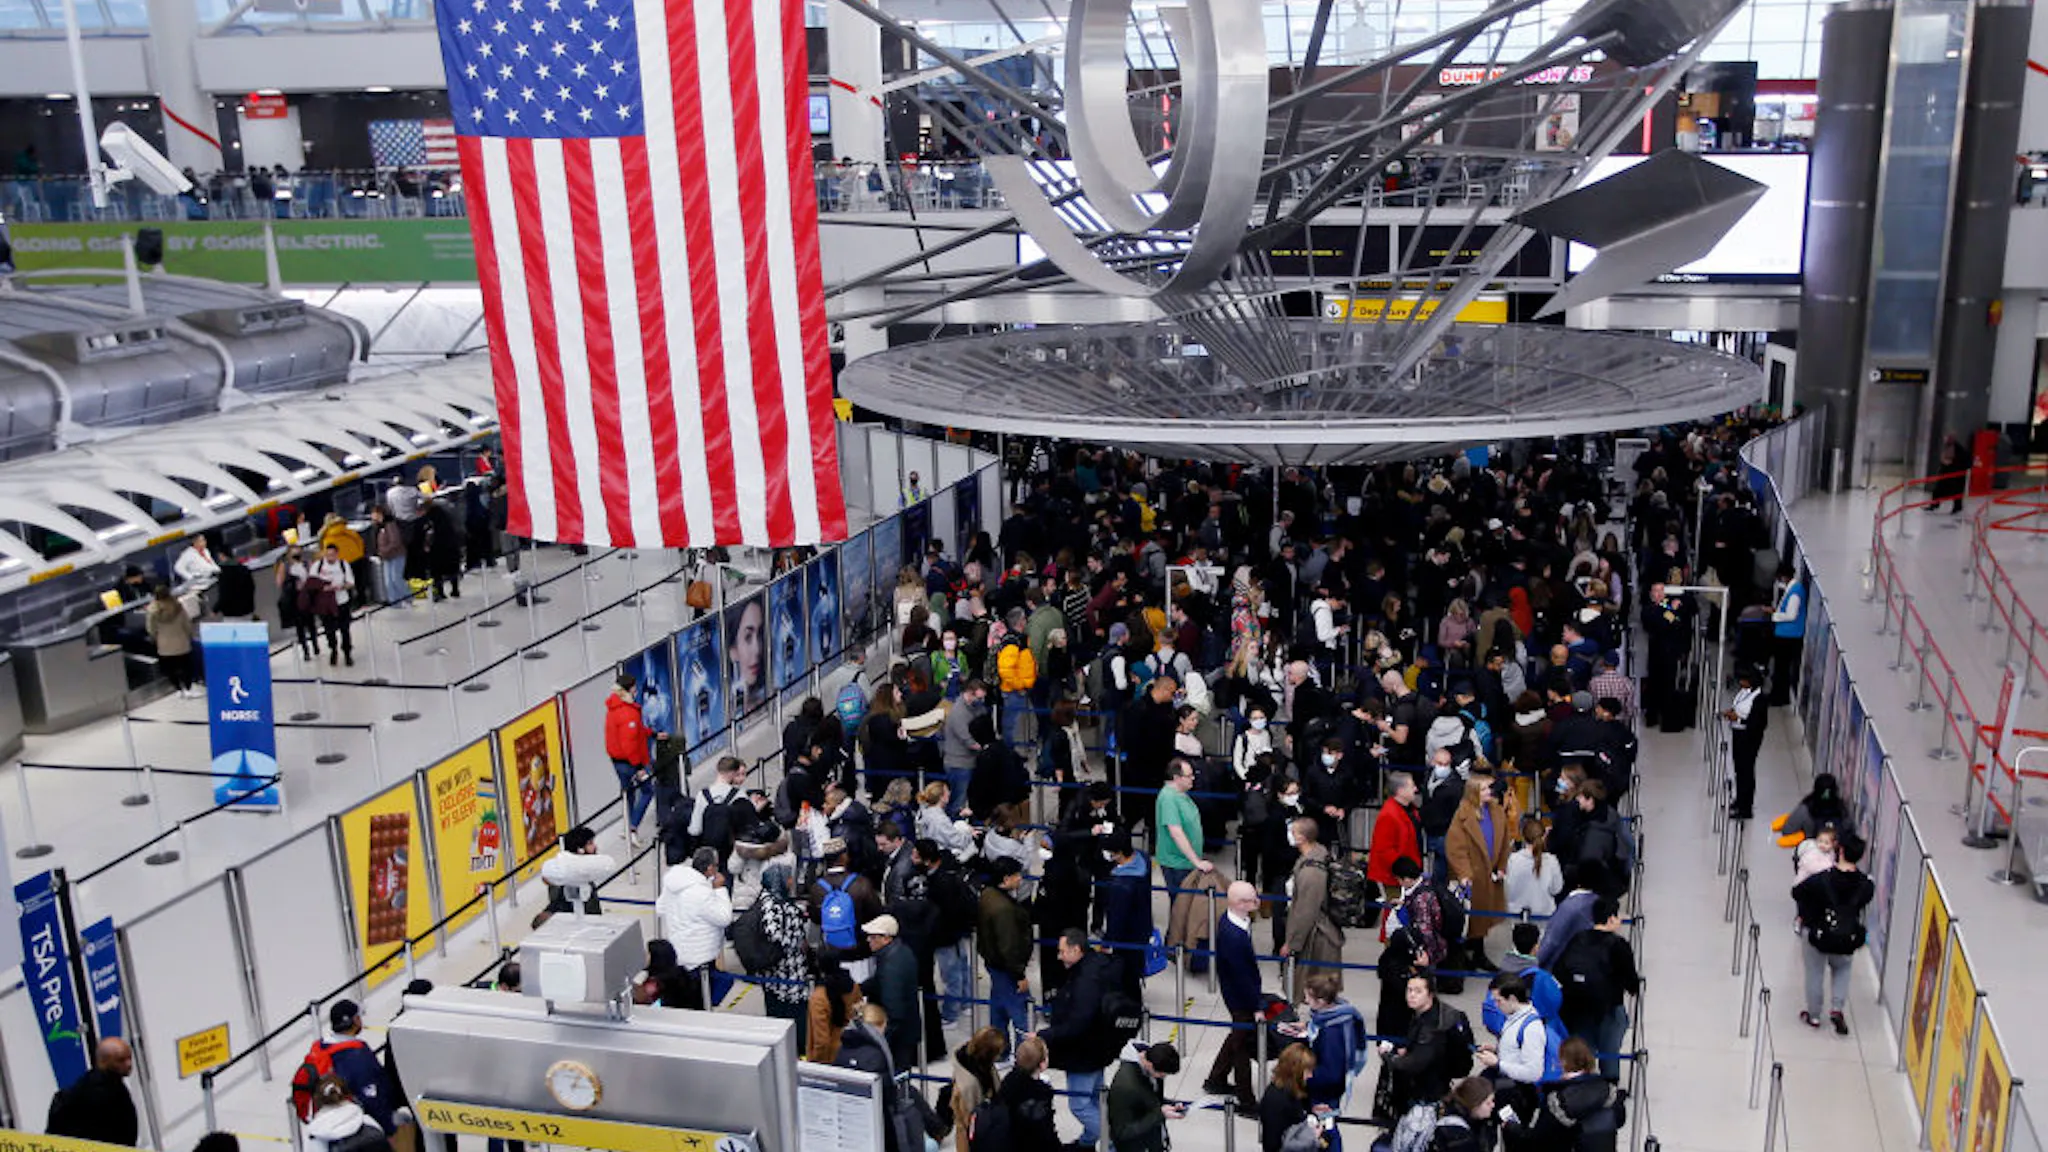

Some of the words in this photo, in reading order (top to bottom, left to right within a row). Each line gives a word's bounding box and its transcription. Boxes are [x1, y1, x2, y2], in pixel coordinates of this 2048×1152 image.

[13, 237, 82, 251] GOING
[167, 236, 196, 250] BY
[221, 710, 260, 721] NORSE
[31, 922, 57, 979] TSA
[428, 1109, 453, 1123] All
[459, 1112, 515, 1131] Gates
[520, 1119, 564, 1138] 1-12
